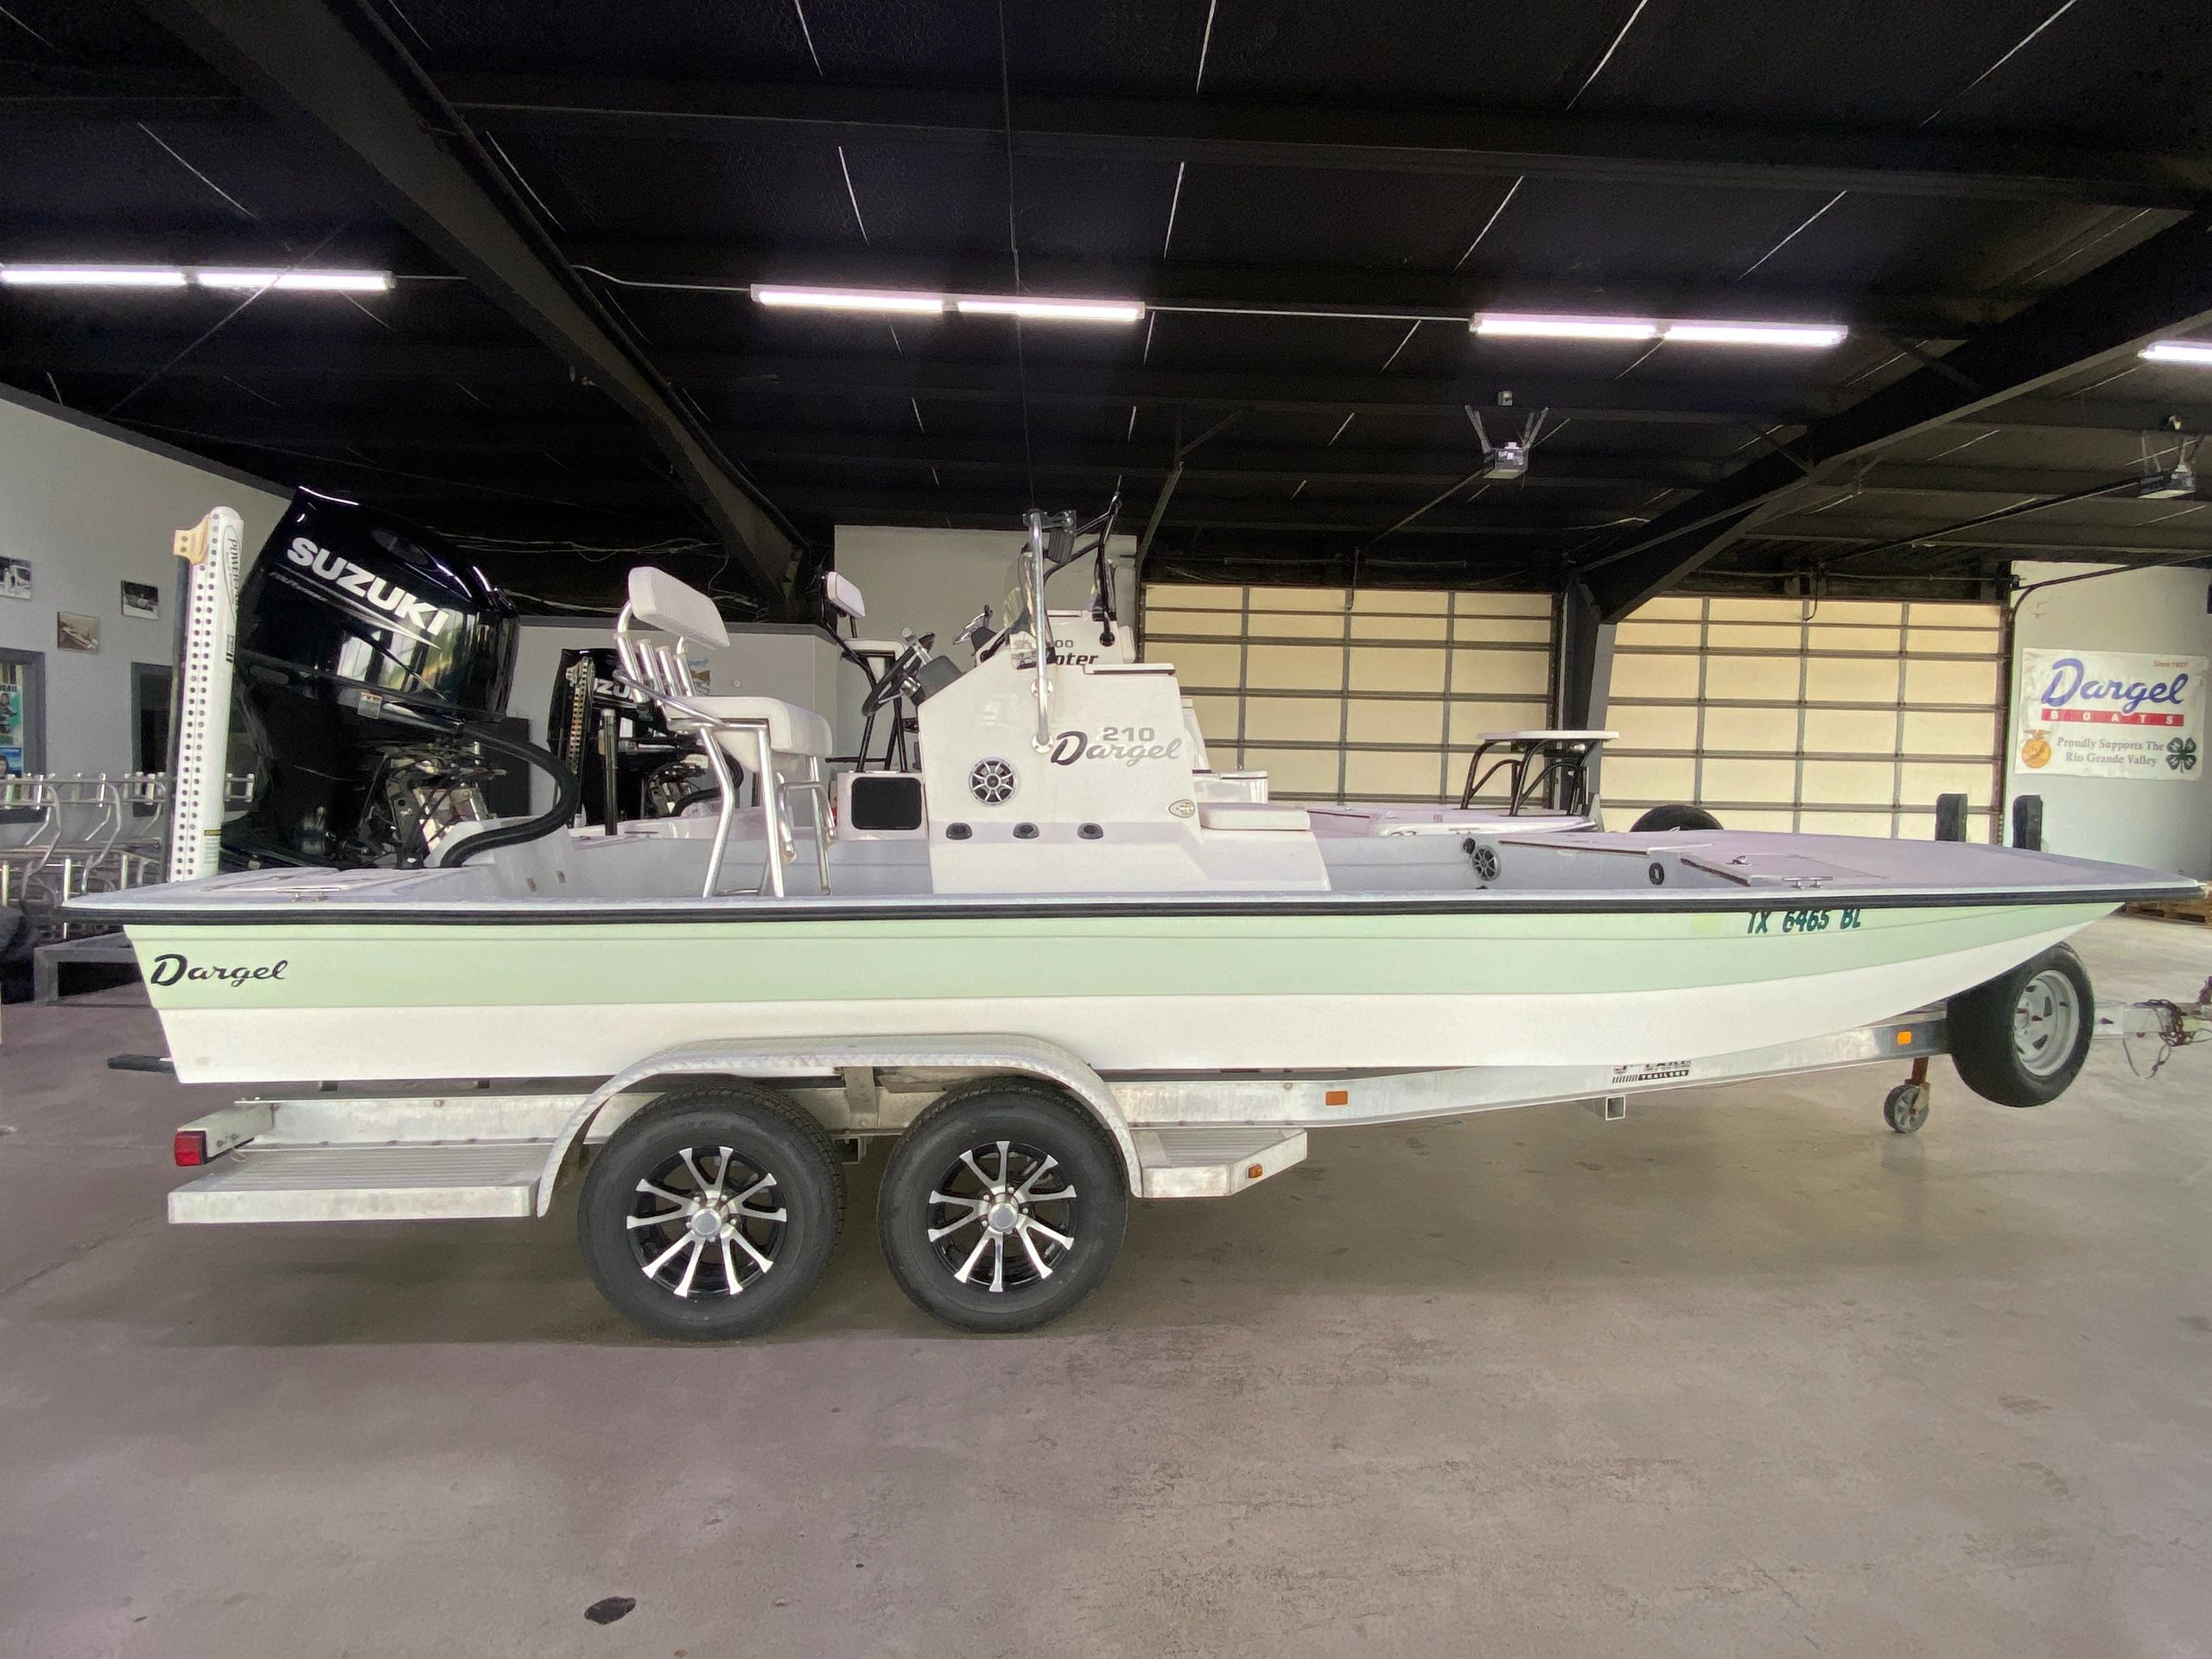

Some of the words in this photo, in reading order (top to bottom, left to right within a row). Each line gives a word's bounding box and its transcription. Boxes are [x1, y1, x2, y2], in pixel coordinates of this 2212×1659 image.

[286, 537, 450, 636] SUZUKI
[1054, 639, 1074, 648] 00
[1055, 652, 1099, 665] oter
[2040, 658, 2189, 714] Dargel
[2050, 709, 2174, 726] BOATS
[1103, 726, 1155, 741] 210
[1050, 730, 1182, 767] Dargel
[2056, 737, 2096, 749] Proudly
[2098, 739, 2143, 752] Supports
[2145, 741, 2164, 752] The
[2065, 752, 2084, 762] Rio
[2086, 752, 2125, 765] Grande
[2127, 754, 2158, 767] Valley
[1747, 911, 1771, 934] TX
[1782, 910, 1830, 933] 6465
[1840, 907, 1861, 930] BL
[150, 953, 289, 988] Dargel
[1641, 1070, 1688, 1081] TRAILERS
